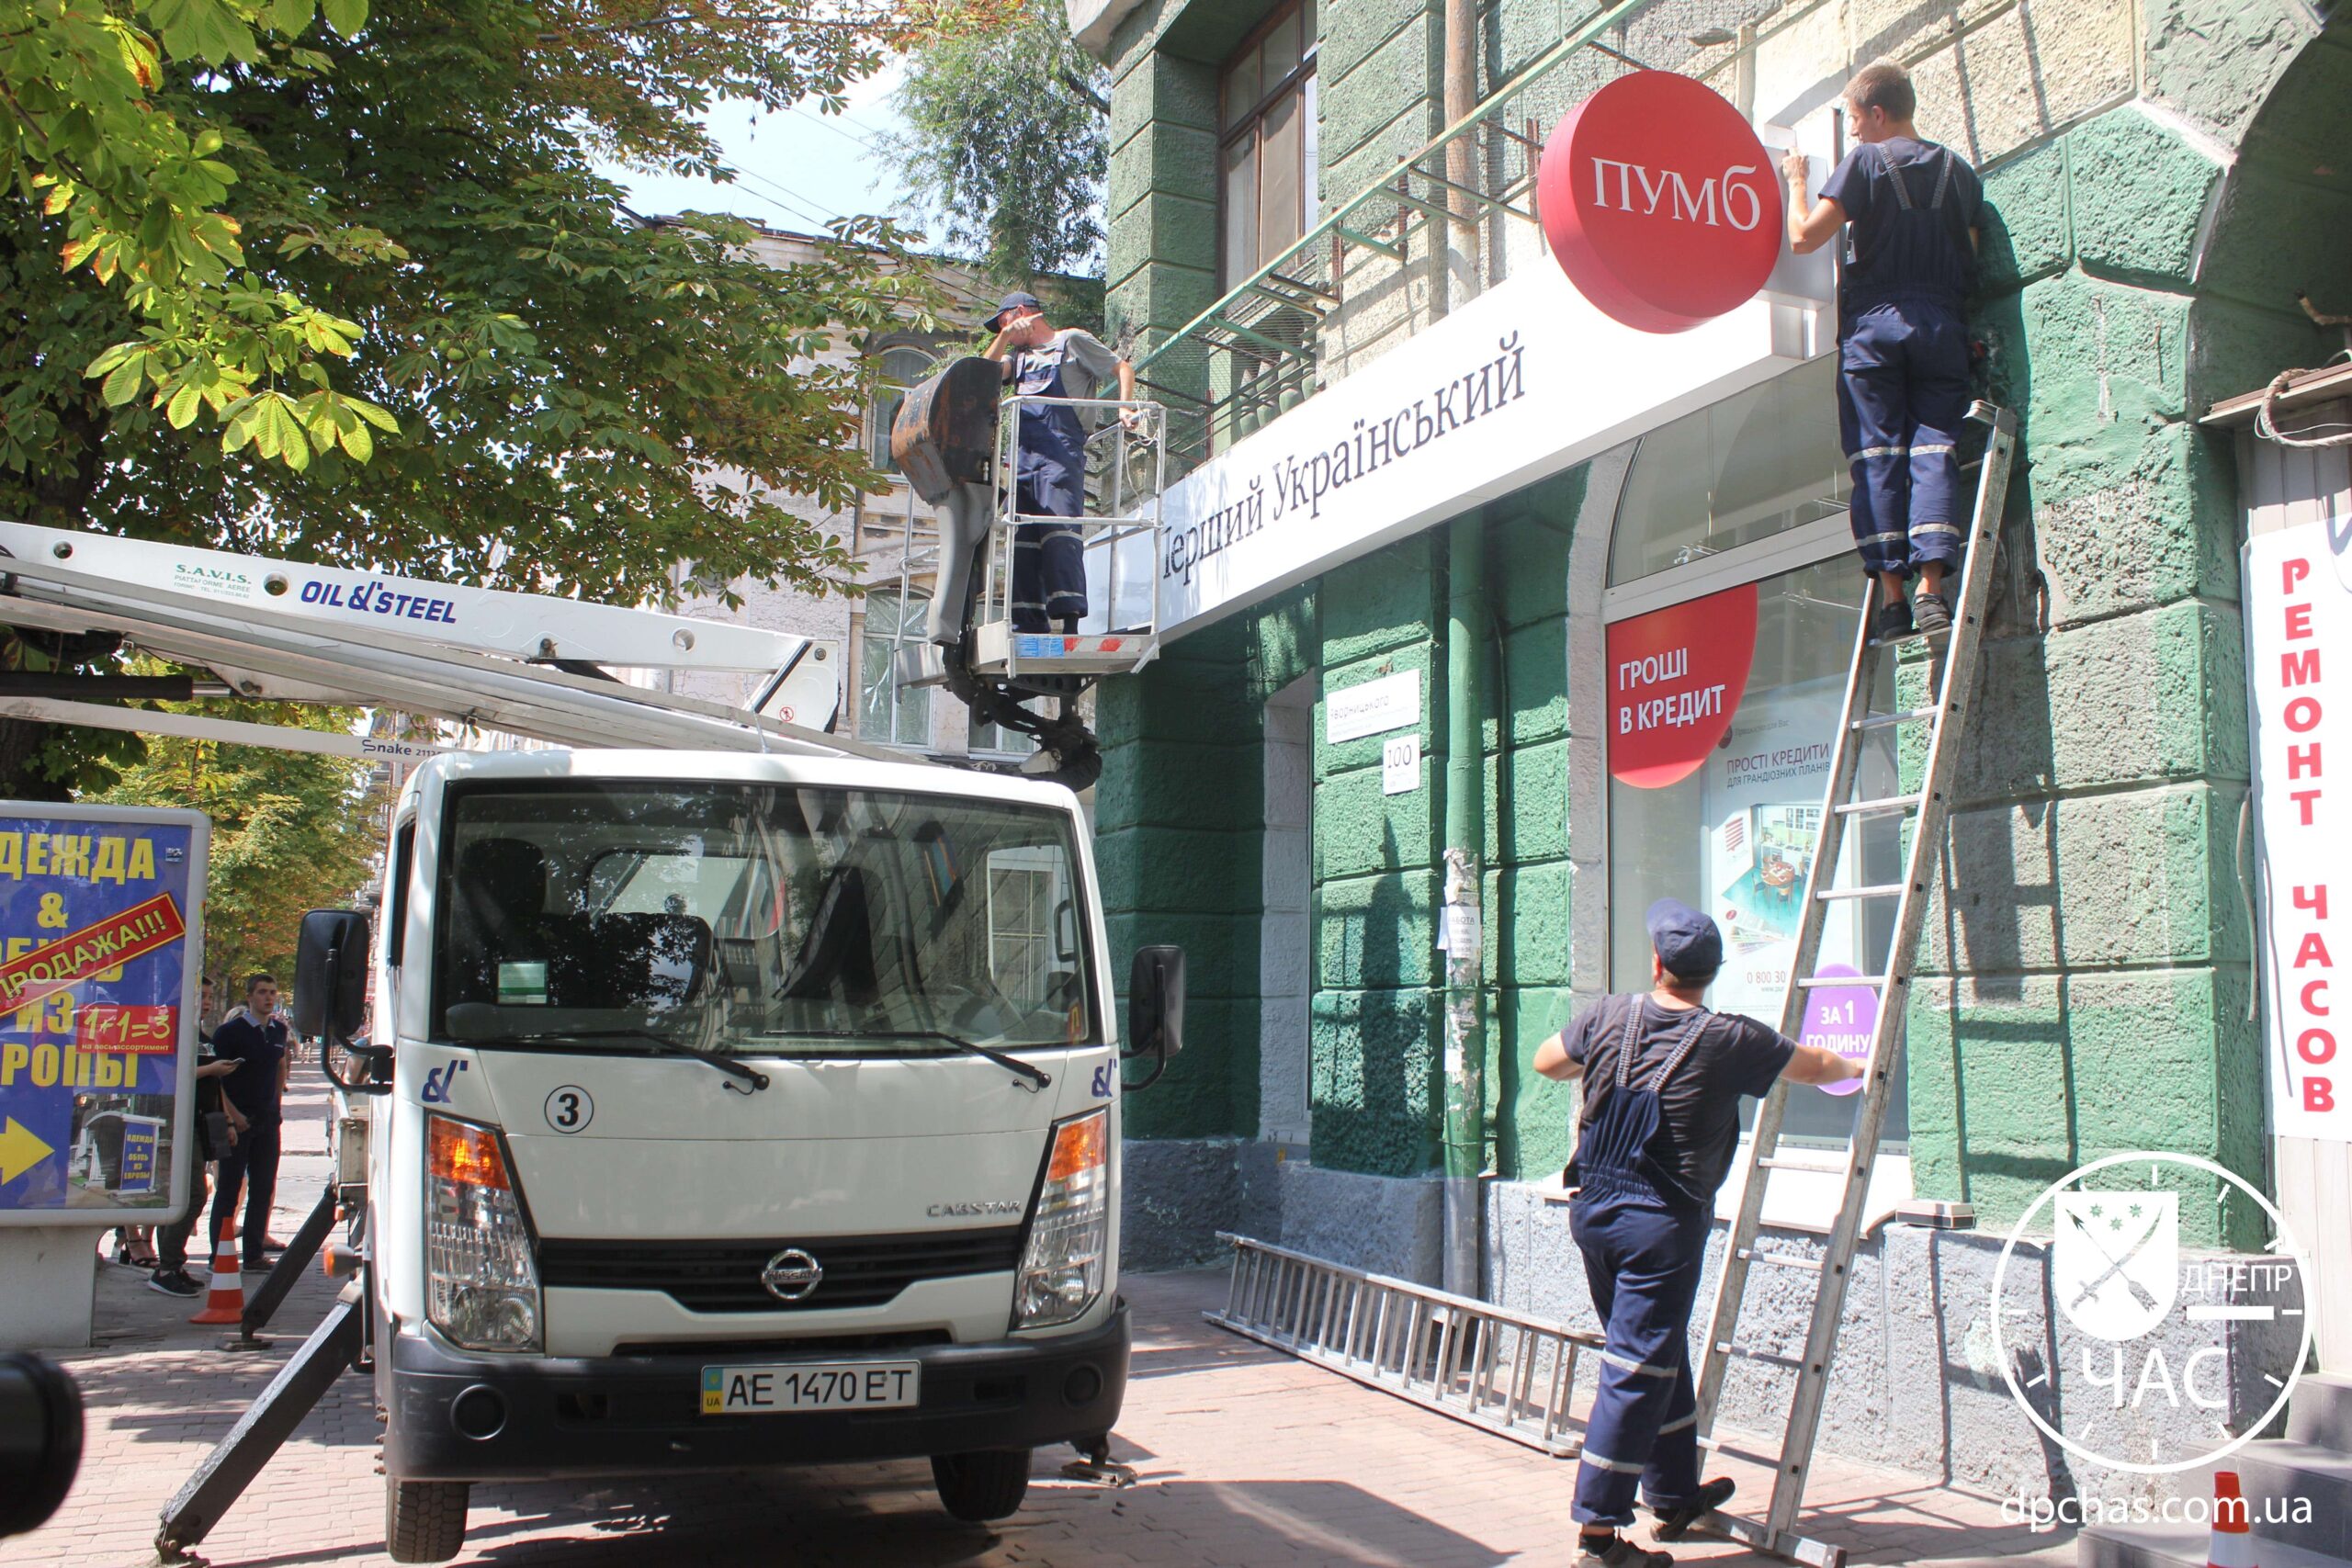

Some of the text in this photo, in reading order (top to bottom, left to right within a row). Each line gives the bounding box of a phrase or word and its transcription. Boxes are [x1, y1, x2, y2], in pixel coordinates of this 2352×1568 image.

[1272, 329, 1525, 521] Український
[175, 564, 252, 584] S.A.V.I.S.
[1620, 647, 1688, 692] ГРОШІ
[1620, 683, 1726, 736] В КРЕДИТ
[362, 739, 413, 755] Snake
[1387, 744, 1412, 769] 100
[1727, 742, 1829, 774] ПРОСТІ КРЕДИТИ
[1727, 761, 1831, 790] ДЛЯ ГРАНДІОЗНИХ ПЛАНІВ
[2280, 557, 2337, 1113] РЕМОНТ ЧАСОВ
[1756, 971, 1771, 984] 800
[16, 991, 75, 1034] ИЗ
[1820, 999, 1854, 1025] ЗА 1
[1805, 1033, 1871, 1054] ГОДИНУ
[557, 1093, 580, 1127] 3
[926, 1200, 1022, 1218] CABSTAR
[768, 1270, 817, 1281] NISSAN
[727, 1370, 912, 1406] AE 1470 ET
[707, 1397, 720, 1407] UA
